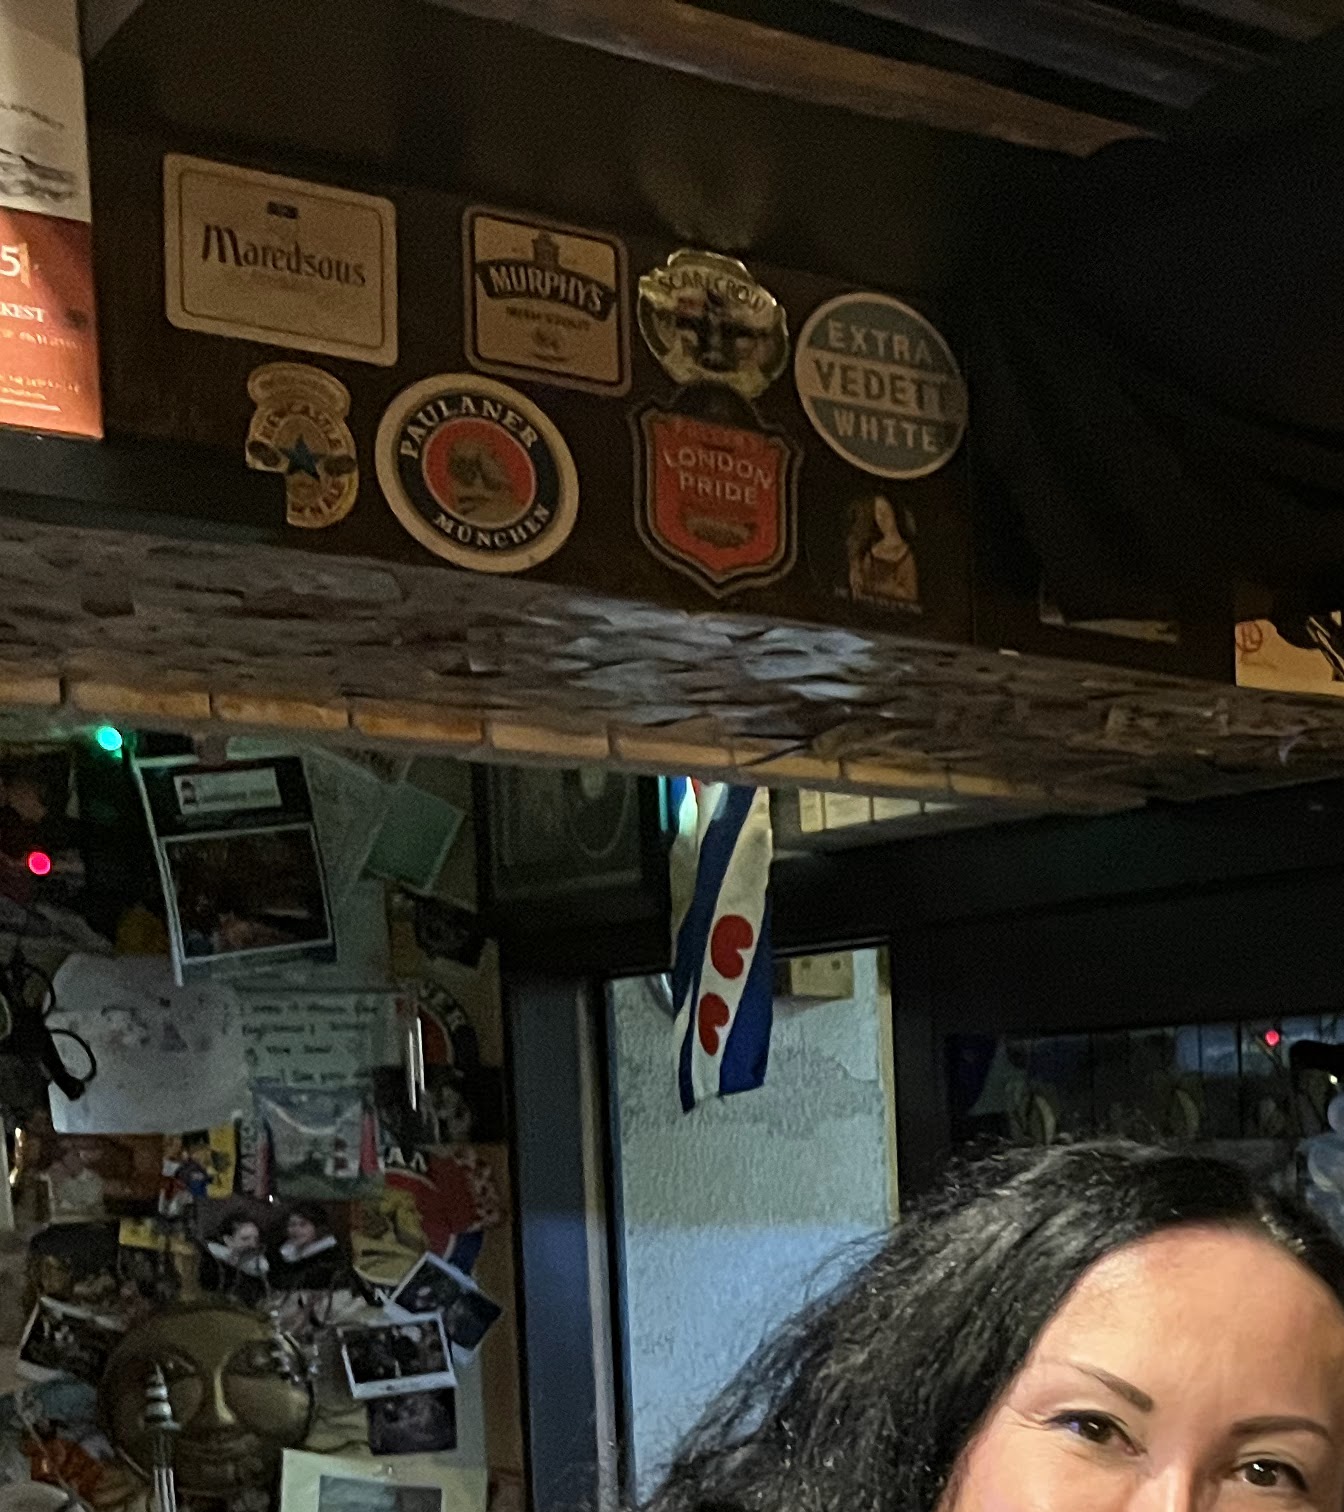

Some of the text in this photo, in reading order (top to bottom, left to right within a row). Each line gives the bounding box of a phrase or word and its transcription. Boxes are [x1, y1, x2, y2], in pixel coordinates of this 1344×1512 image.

[202, 225, 366, 288] Maredsous
[828, 318, 934, 364] EXTRA
[400, 394, 540, 460] PAULANER
[833, 410, 940, 453] WHITE
[662, 446, 774, 492] LONDON
[678, 470, 759, 506] PRIDE
